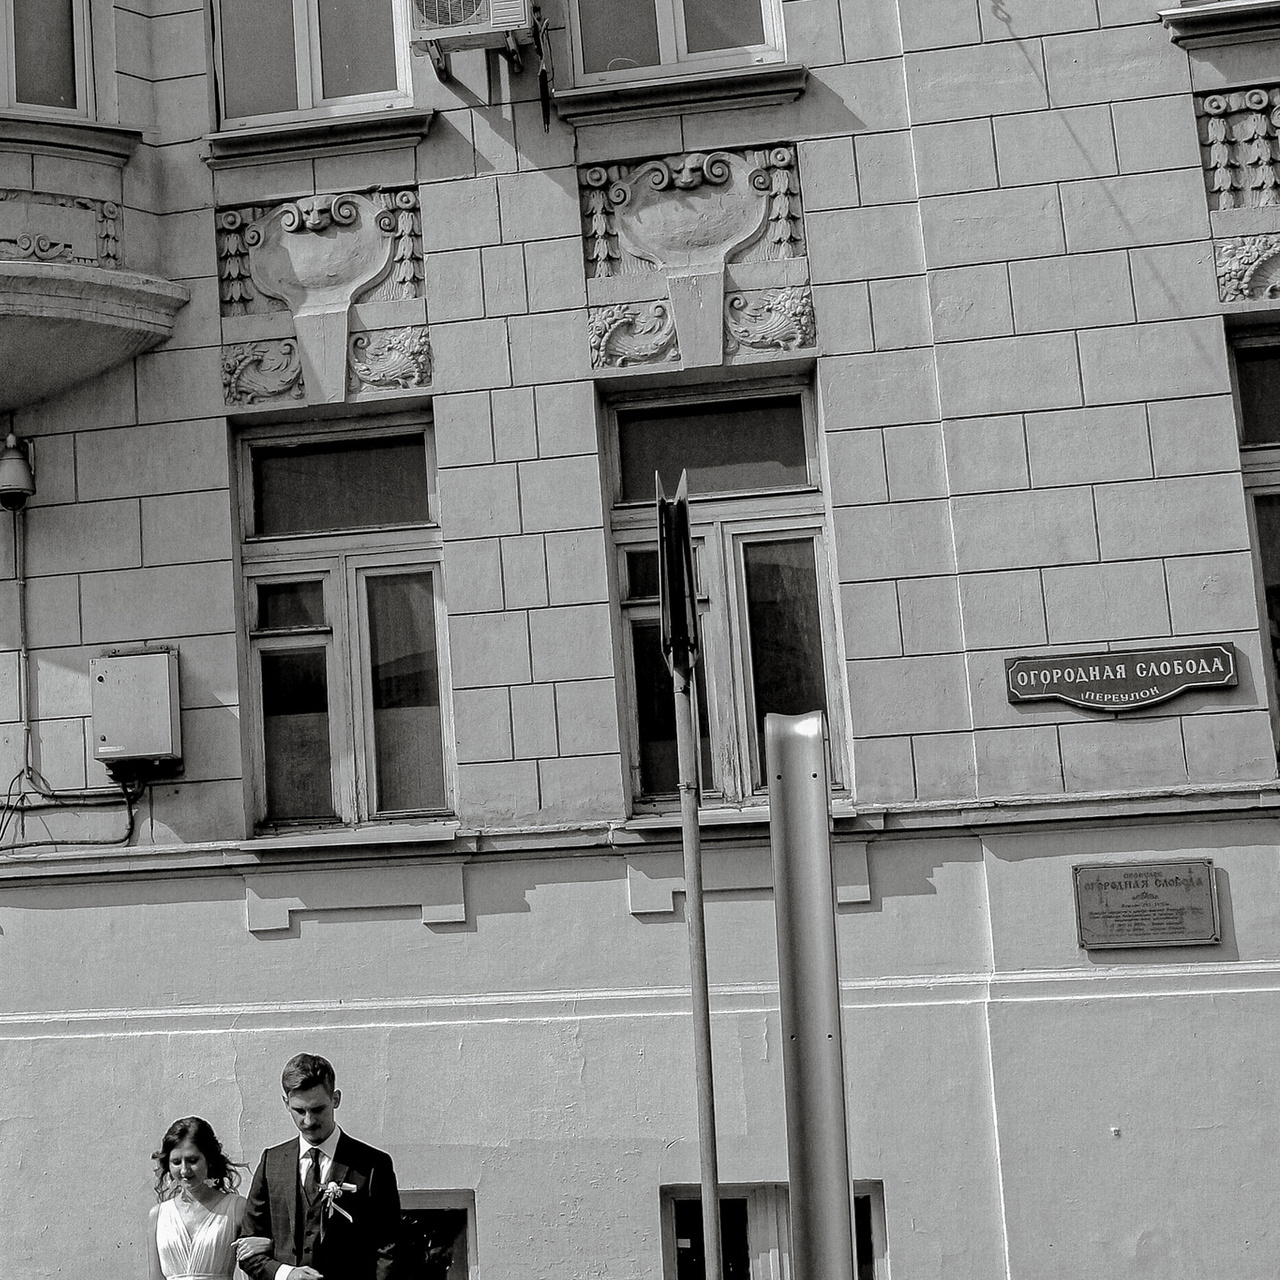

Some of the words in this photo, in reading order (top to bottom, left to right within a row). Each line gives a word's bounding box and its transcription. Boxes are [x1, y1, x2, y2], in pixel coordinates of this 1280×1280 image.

[1017, 664, 1126, 686] ОГОРОДНАЯ
[1136, 658, 1224, 677] СЛОБОДА
[1085, 686, 1160, 702] ПЕРЕУЛОК
[1084, 881, 1149, 891] ОГОРОДНАЯ
